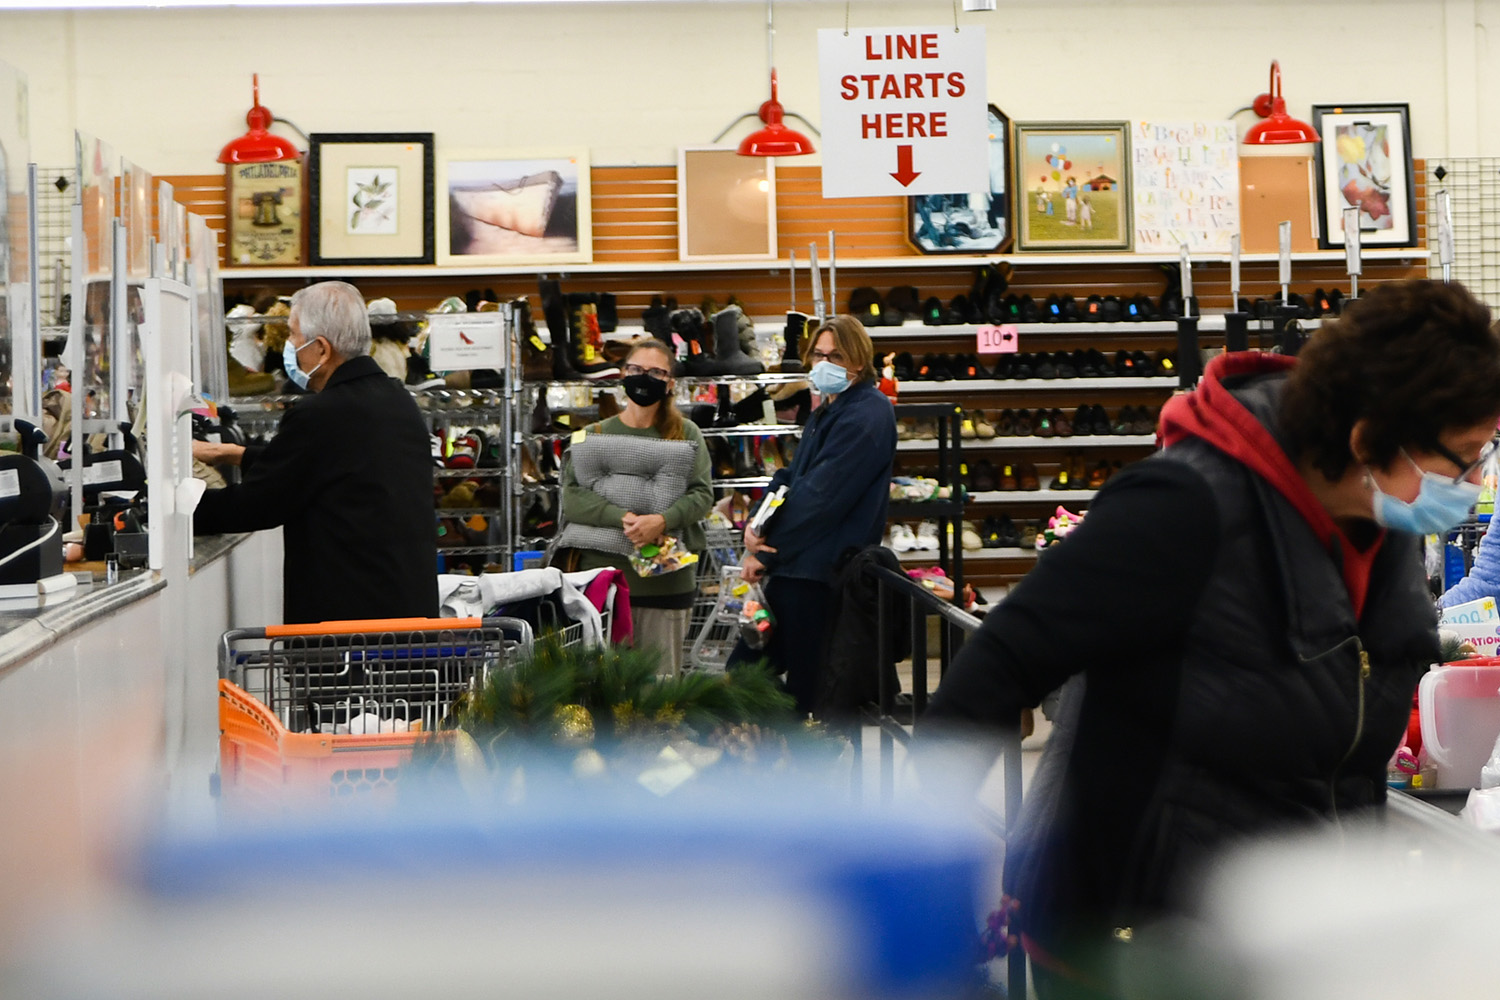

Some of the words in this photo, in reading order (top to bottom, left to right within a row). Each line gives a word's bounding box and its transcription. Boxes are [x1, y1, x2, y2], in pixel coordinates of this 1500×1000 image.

[865, 34, 939, 60] LINE
[840, 72, 966, 100] STARTS
[861, 112, 947, 139] HERE
[983, 329, 1002, 347] 10
